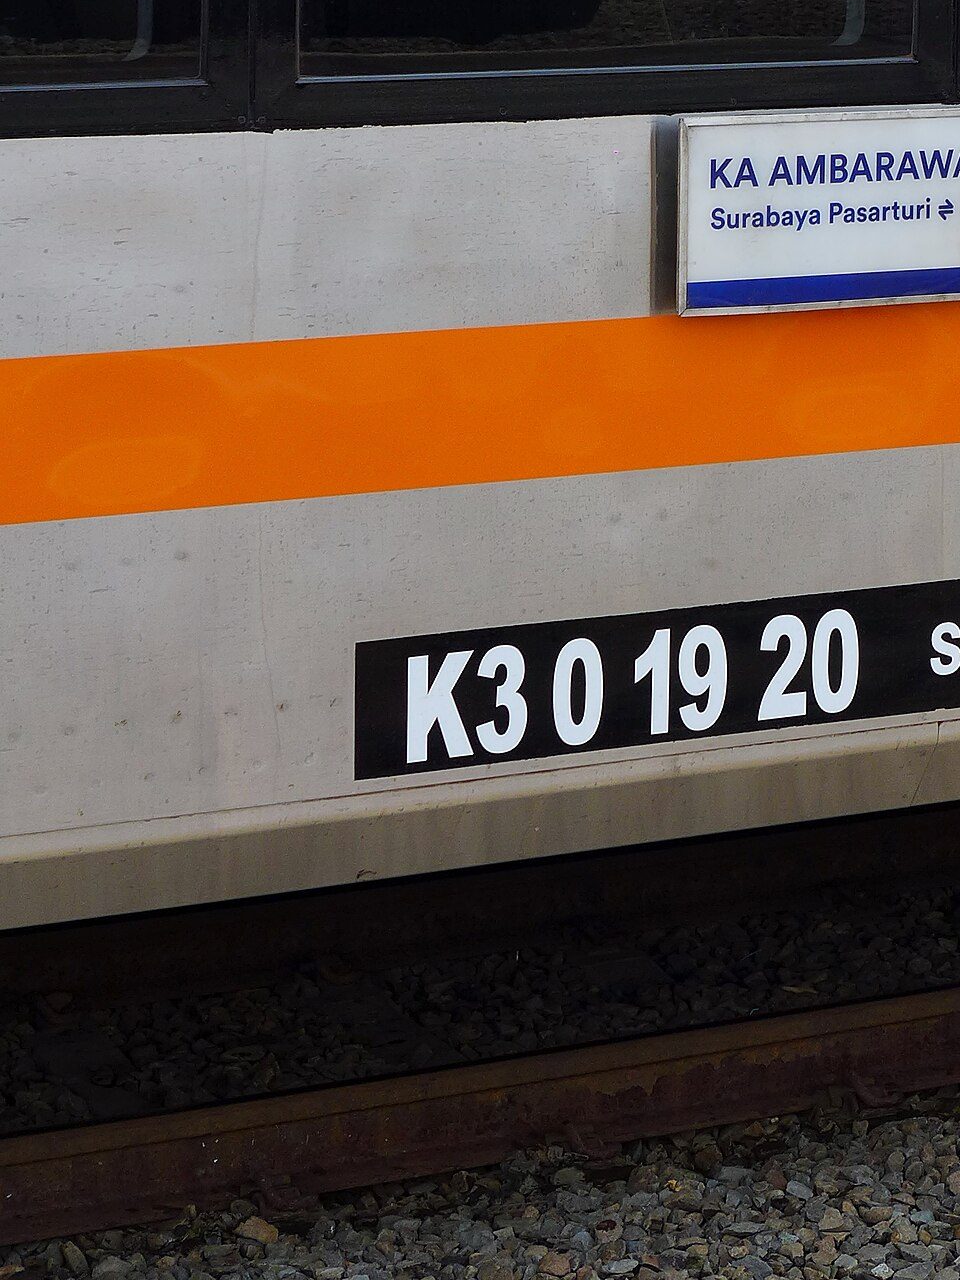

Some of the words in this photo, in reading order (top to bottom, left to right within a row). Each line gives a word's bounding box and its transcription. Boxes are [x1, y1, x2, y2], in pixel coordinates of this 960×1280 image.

[710, 157, 759, 190] KA
[710, 205, 821, 232] Surabaya
[829, 197, 932, 224] Pasarturi
[407, 644, 528, 764] K3
[552, 637, 604, 746] 0
[635, 624, 728, 735] 19
[758, 608, 860, 722] 20
